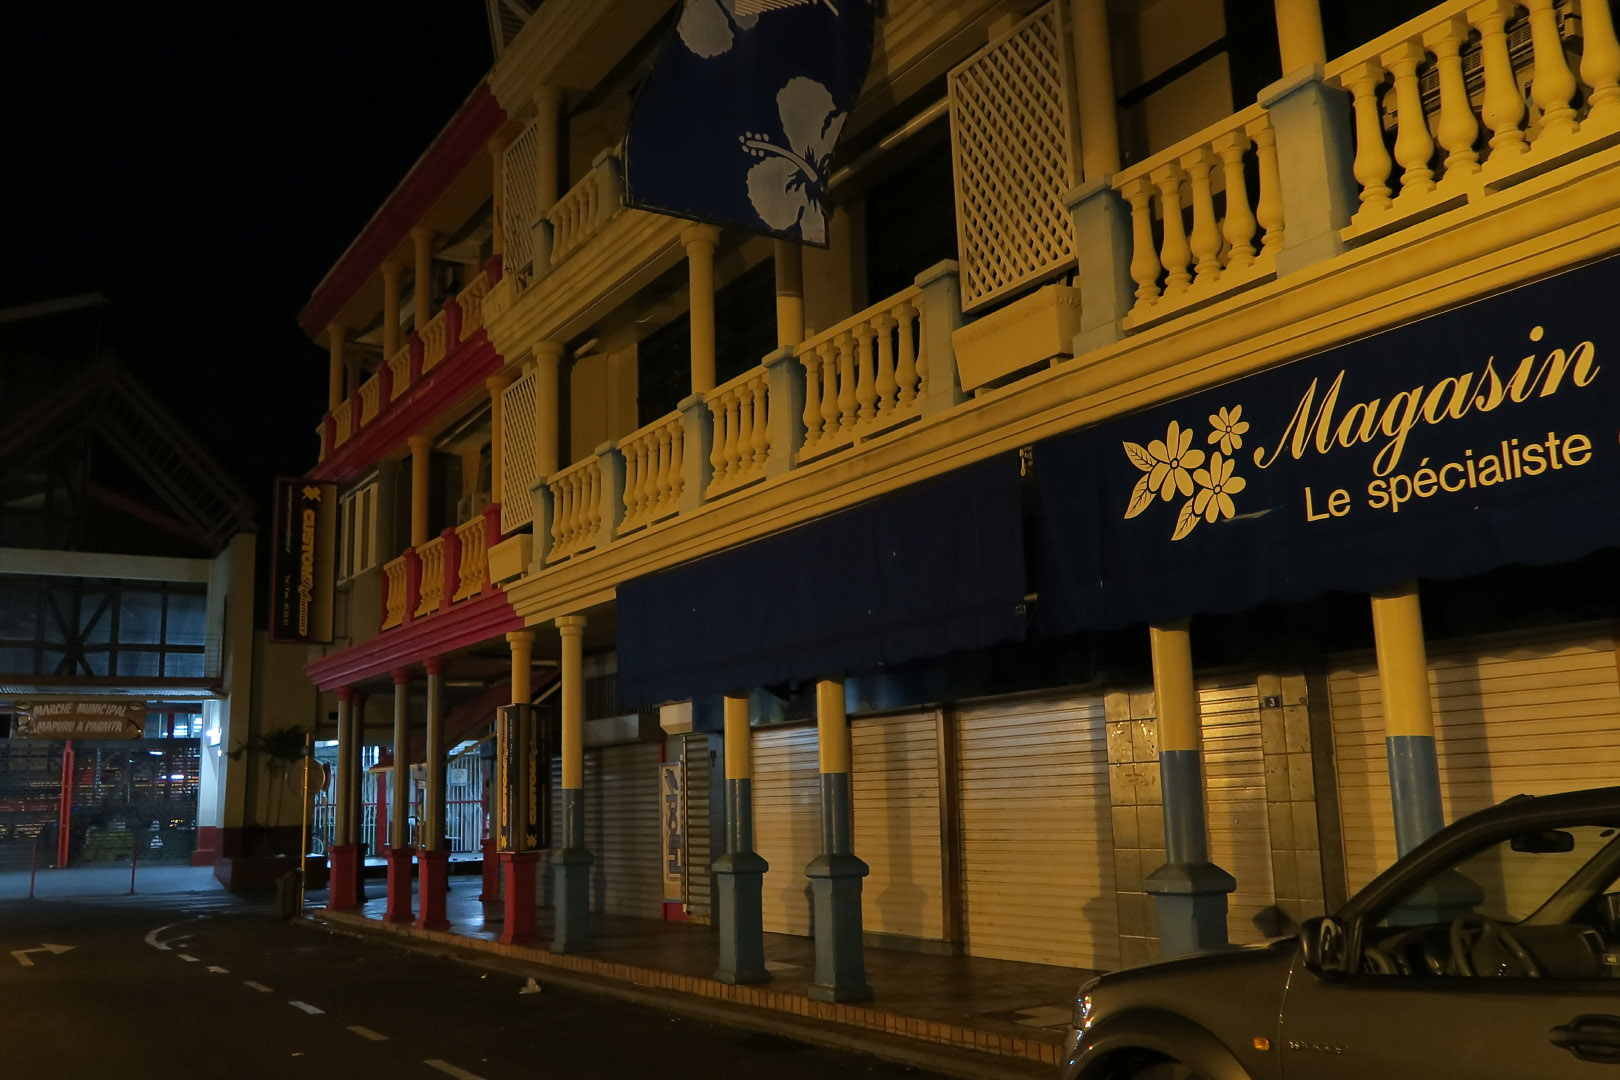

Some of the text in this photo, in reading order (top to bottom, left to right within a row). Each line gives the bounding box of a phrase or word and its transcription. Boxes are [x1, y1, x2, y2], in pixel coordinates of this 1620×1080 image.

[1252, 325, 1601, 477] Magasin
[1304, 431, 1594, 523] Le spécialiste
[301, 508, 315, 579] CUSTOM
[76, 703, 127, 717] MUNICIPAL
[1269, 697, 1276, 707] 3
